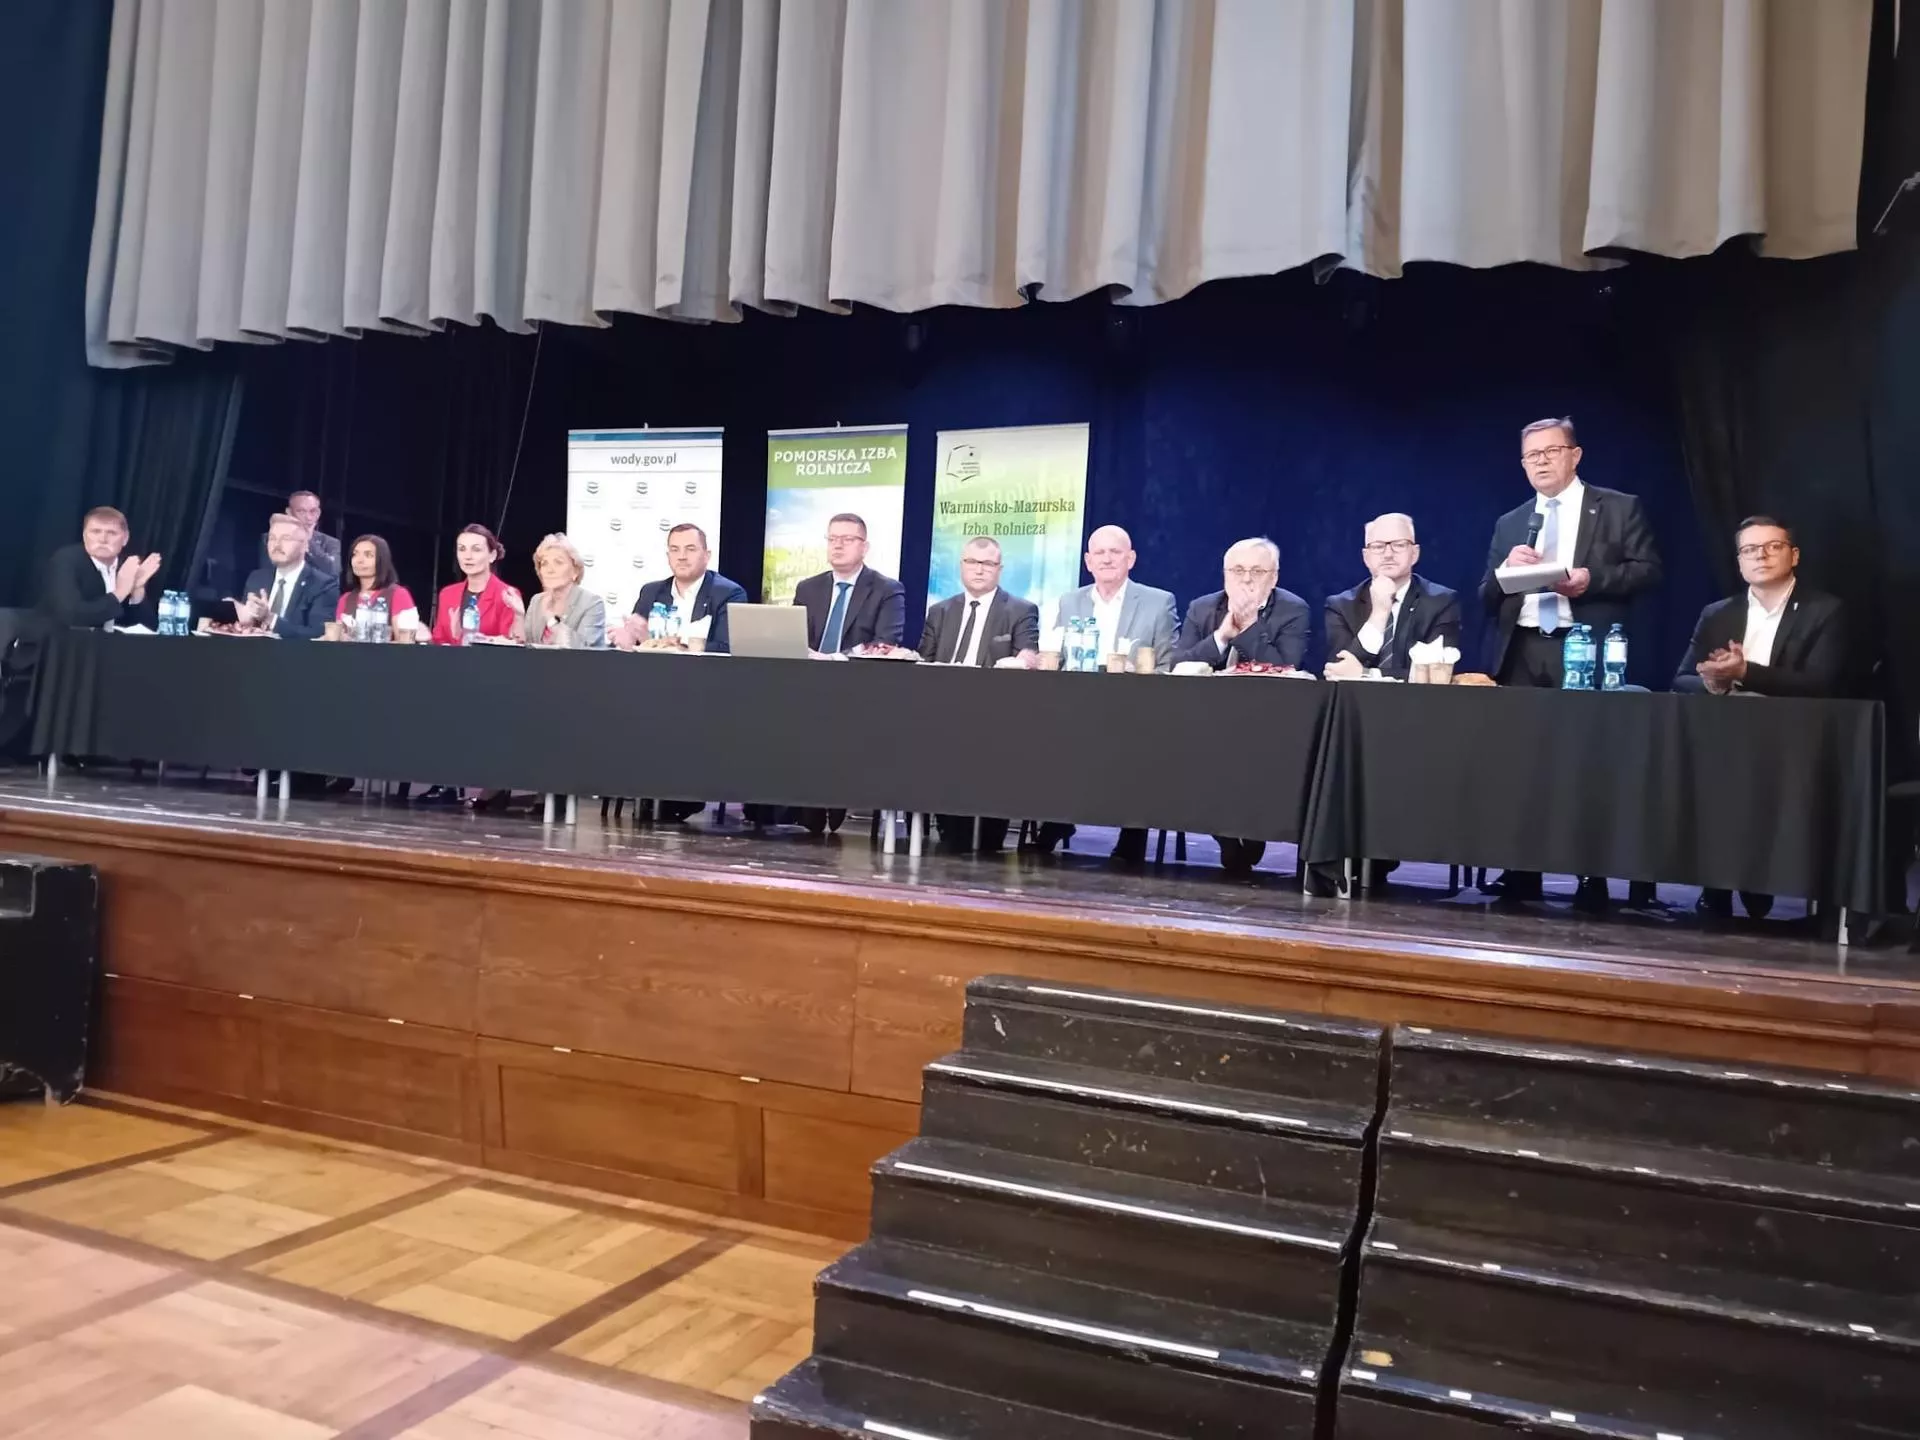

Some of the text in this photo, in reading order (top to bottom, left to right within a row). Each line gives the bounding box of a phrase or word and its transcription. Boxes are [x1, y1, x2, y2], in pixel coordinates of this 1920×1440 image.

[611, 452, 677, 466] wody.gov.pl
[774, 446, 898, 463] POMORSKA IZBA
[795, 461, 872, 476] ROLNICZA
[939, 498, 1076, 515] Warmińsko-Mazurska
[962, 522, 1047, 536] Izba Rolnicza
